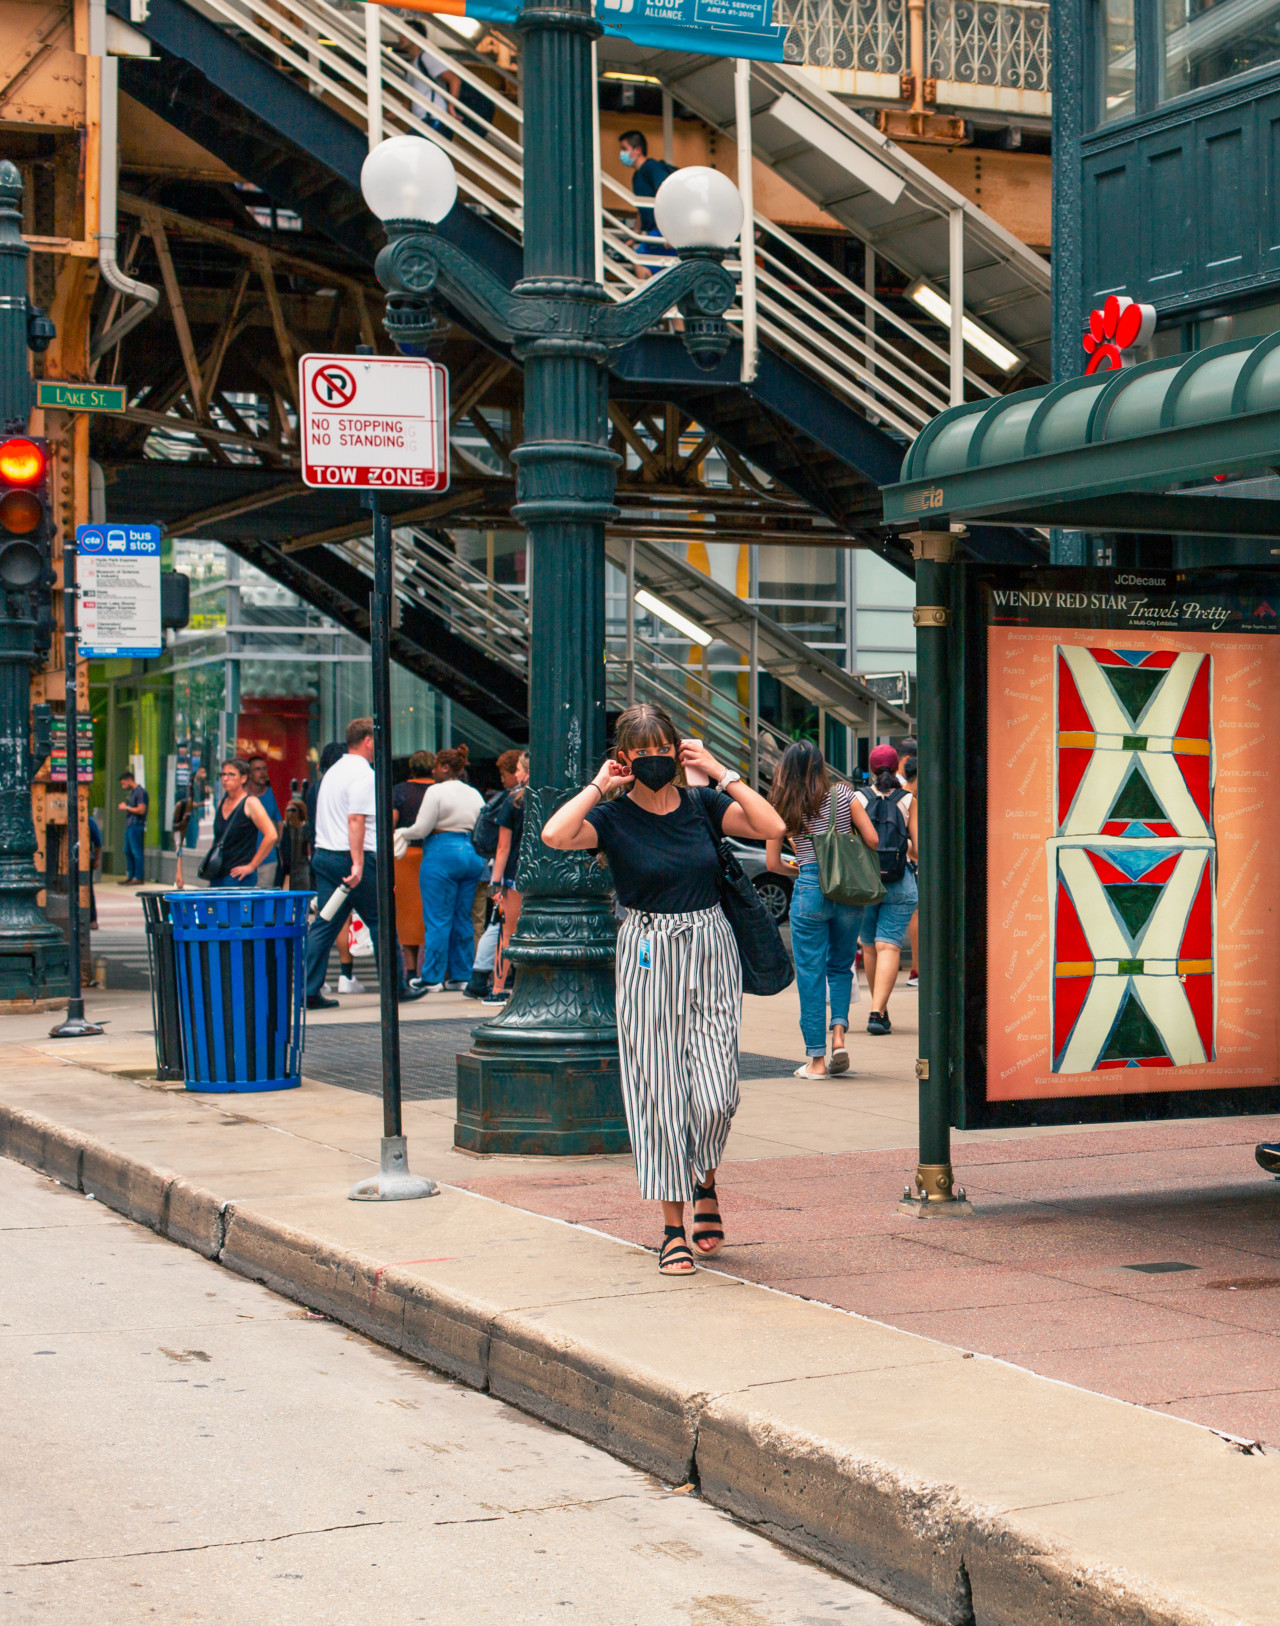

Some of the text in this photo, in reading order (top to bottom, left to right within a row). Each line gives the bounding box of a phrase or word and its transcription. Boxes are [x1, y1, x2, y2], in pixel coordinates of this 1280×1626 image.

[732, 2, 761, 11] SERVICE
[645, 7, 686, 20] ALLIANCE.
[728, 9, 754, 18] #1-2015
[56, 388, 107, 406] LAKE ST.
[312, 418, 403, 433] NO STOPPING
[312, 434, 404, 447] NO STANDING
[313, 467, 424, 485] TOW ZONE
[129, 530, 151, 540] bus
[129, 541, 156, 552] stop
[1115, 575, 1166, 586] JCDecaux
[993, 590, 1231, 630] WENDY RED STAR Travels Pretty
